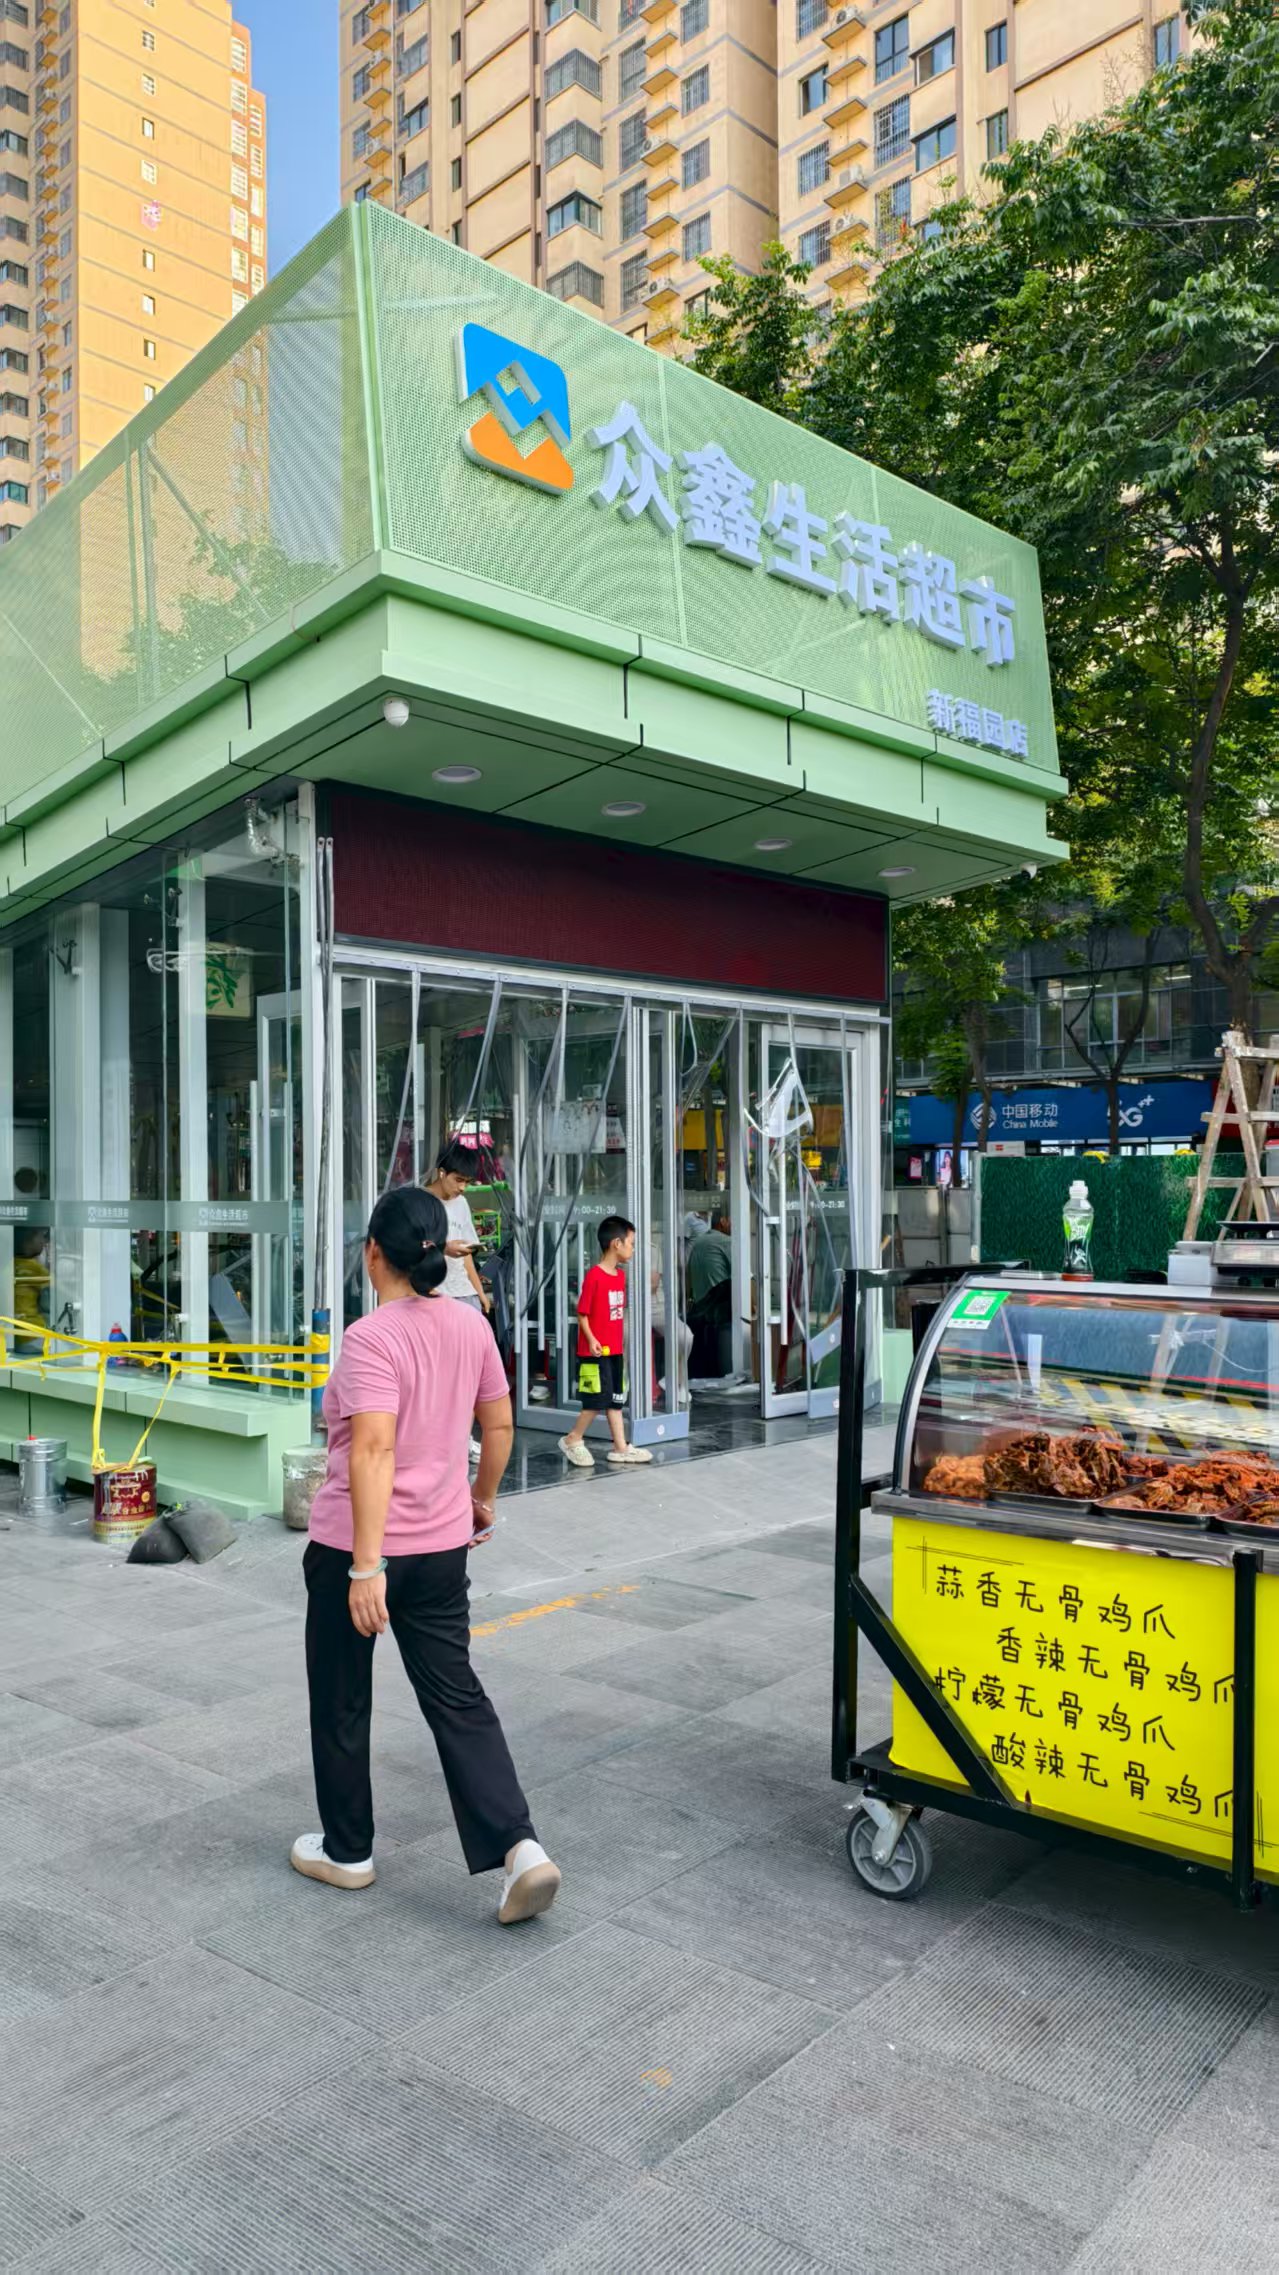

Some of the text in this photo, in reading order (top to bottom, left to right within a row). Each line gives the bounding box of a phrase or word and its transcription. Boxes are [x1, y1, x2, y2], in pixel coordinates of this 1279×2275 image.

[586, 400, 1016, 668] 众鑫生活超市
[927, 688, 1028, 760] 新福园店
[1002, 1104, 1058, 1119] 中国移动
[1003, 1118, 1058, 1129] China Mobile
[936, 1564, 1176, 1640] 蒜香无骨鸡爪
[935, 1667, 1176, 1751] 柠檬无骨鸡爪
